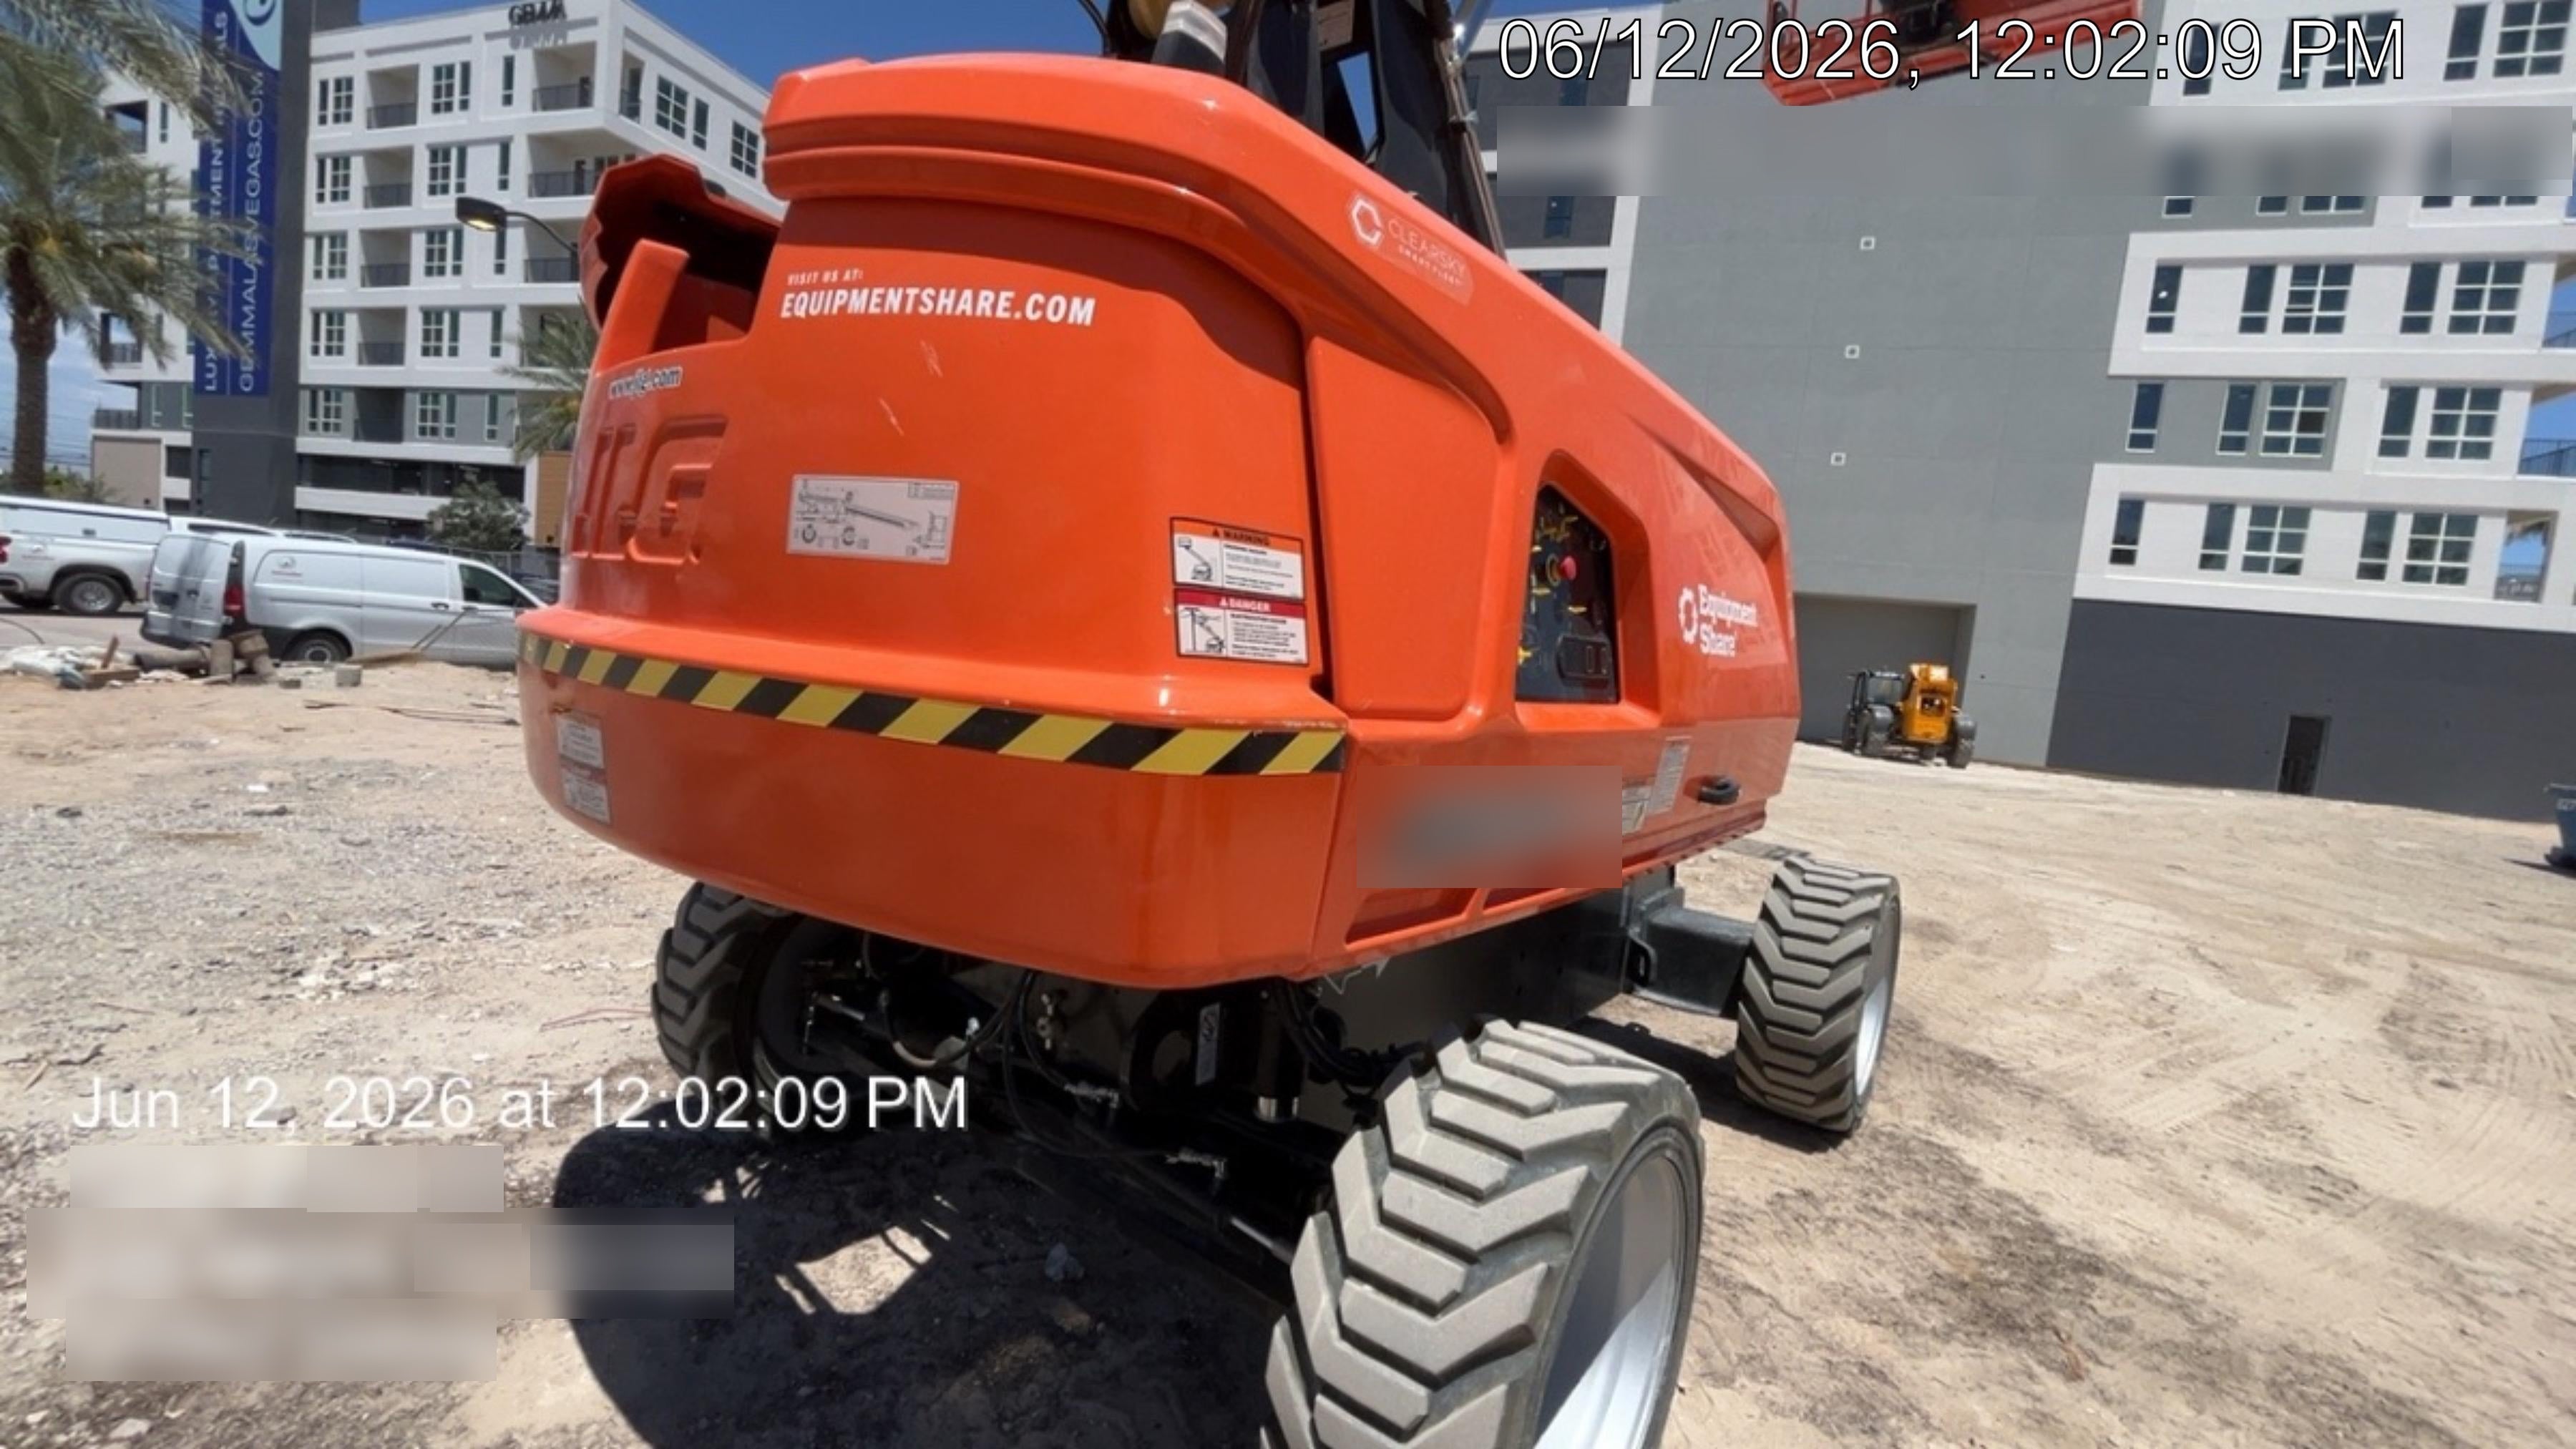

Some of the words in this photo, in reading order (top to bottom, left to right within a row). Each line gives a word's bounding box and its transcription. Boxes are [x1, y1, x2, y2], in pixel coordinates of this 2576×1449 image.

[207, 134, 224, 288] PTMENT
[788, 271, 820, 286] VISIT
[822, 269, 839, 283] US
[781, 286, 1096, 327] EQUIPMENTSHARE.COM
[205, 296, 218, 391] LUXY
[1229, 597, 1272, 613] DANGER
[1697, 583, 1758, 628] Equipment
[1700, 623, 1737, 658] Share
